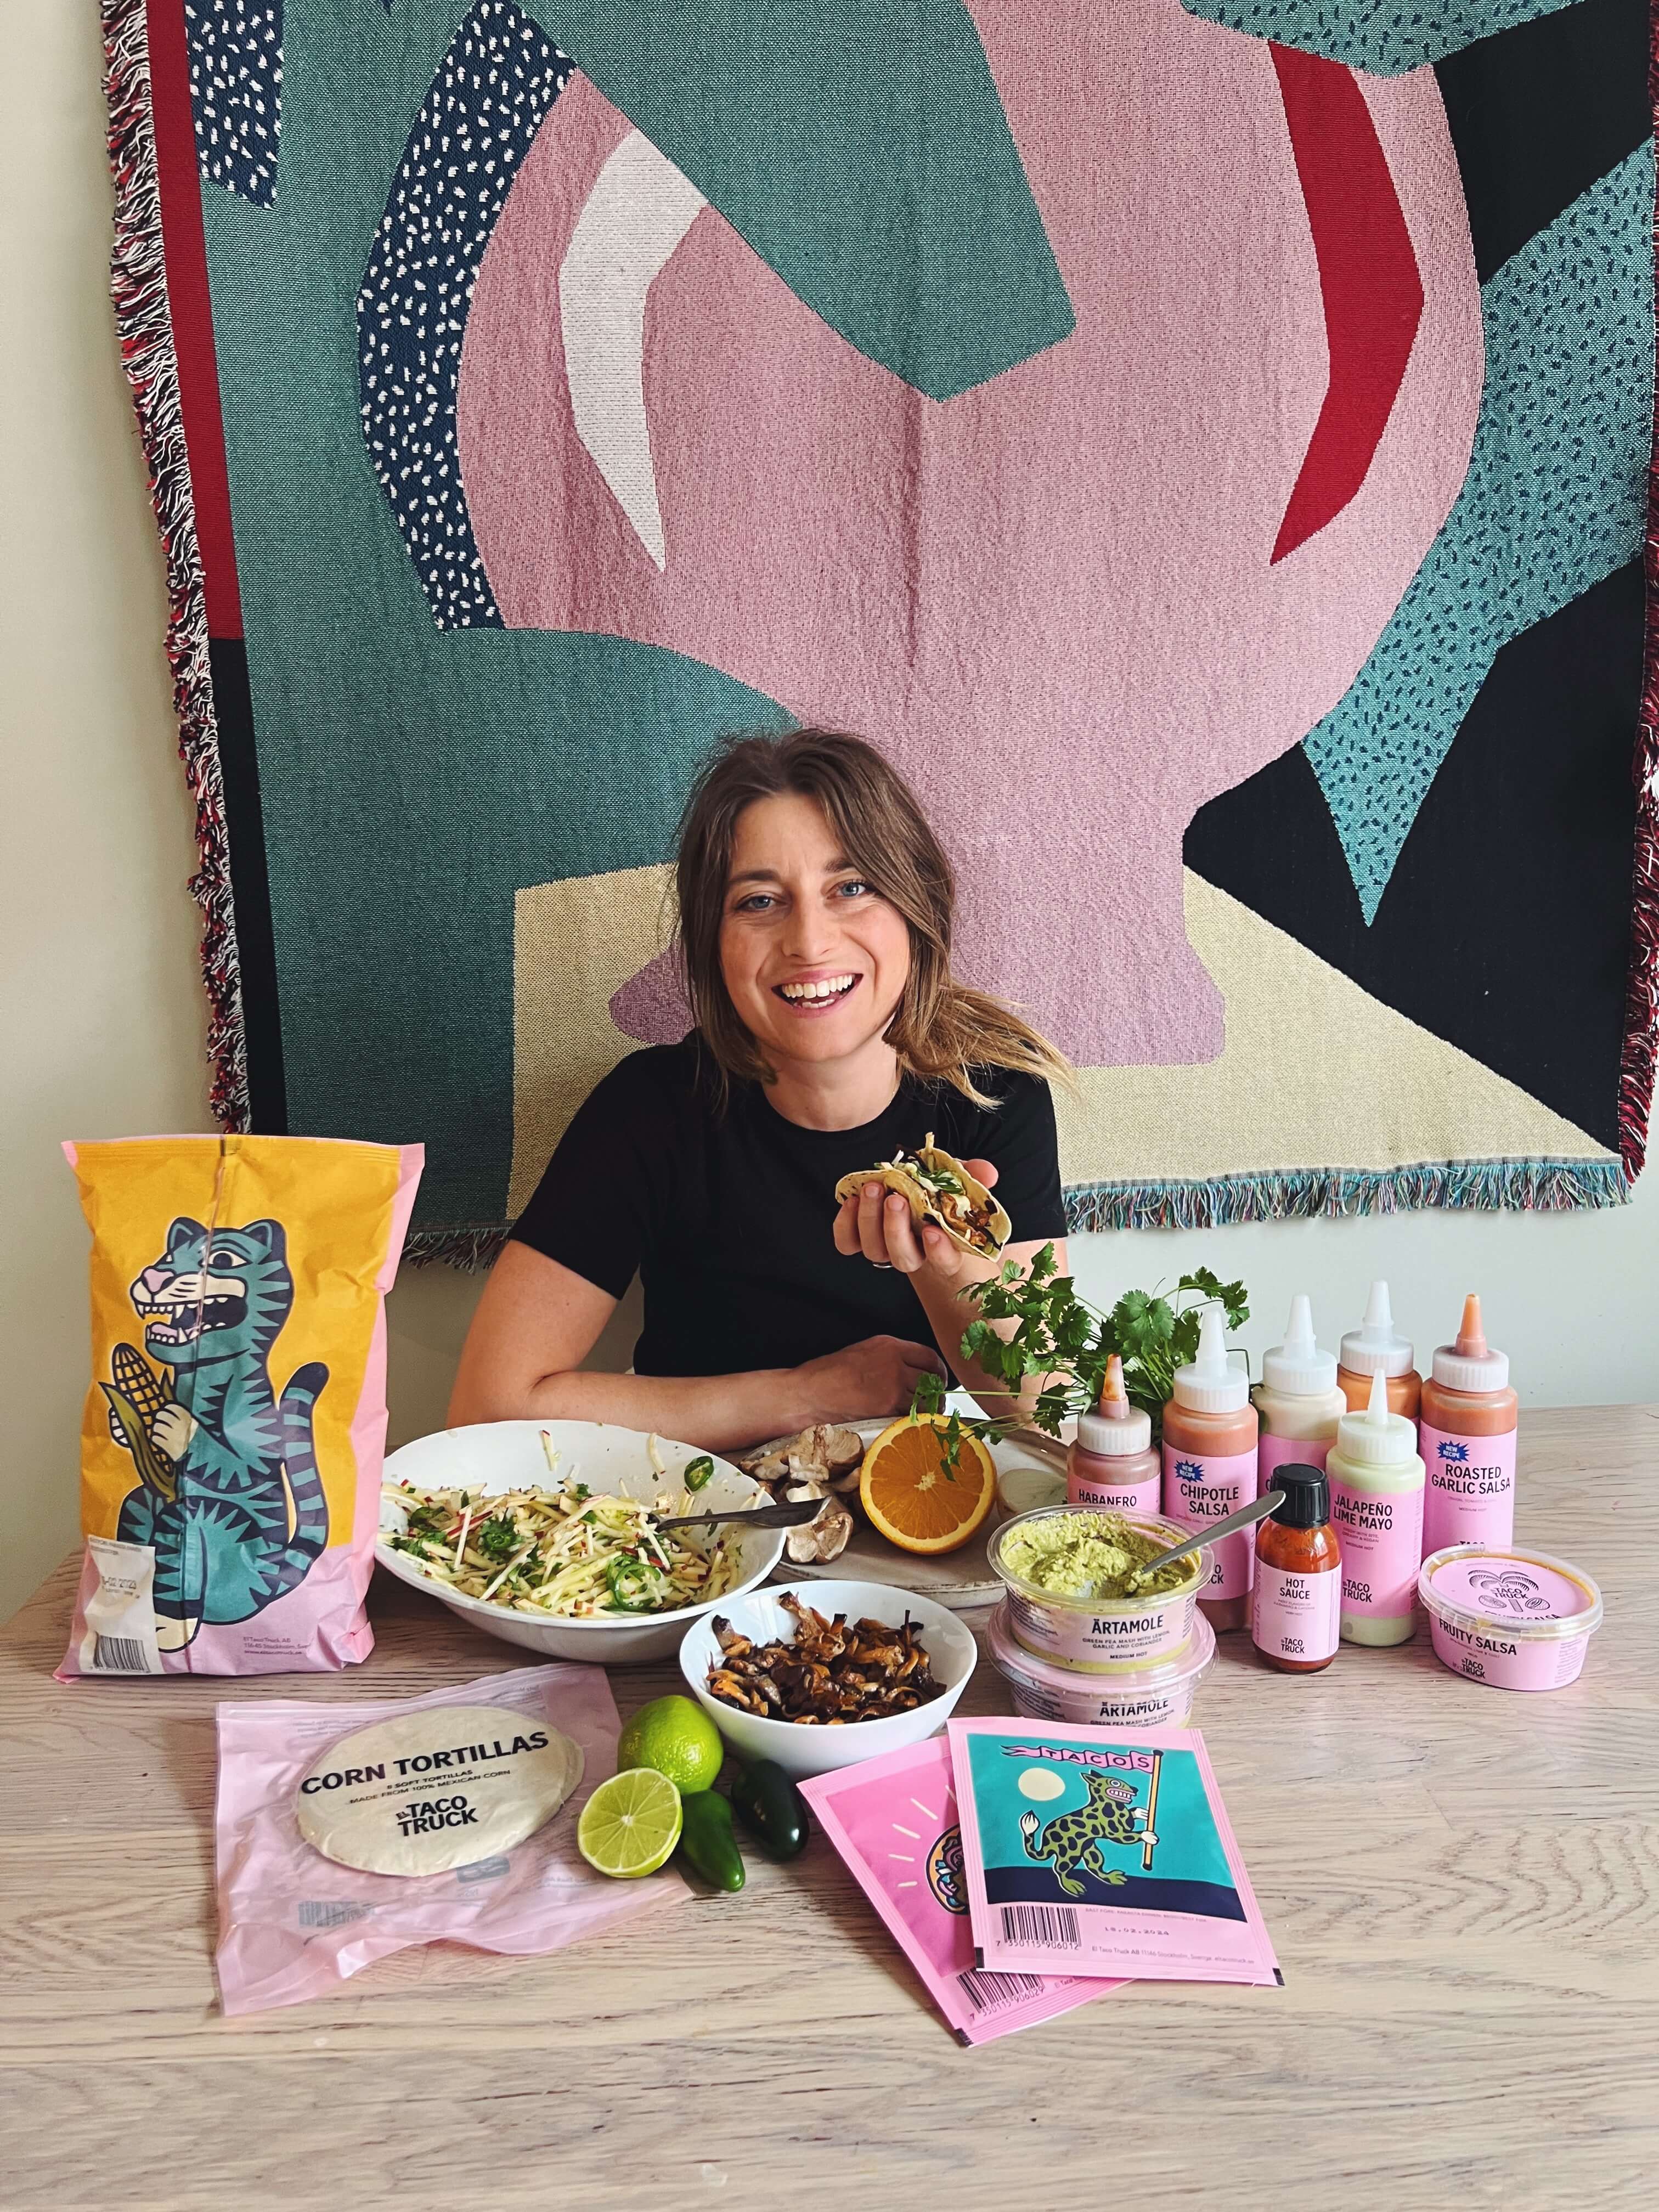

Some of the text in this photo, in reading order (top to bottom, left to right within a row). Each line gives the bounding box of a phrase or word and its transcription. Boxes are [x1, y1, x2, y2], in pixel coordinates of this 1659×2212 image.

[1443, 1450, 1460, 1459] RECIPE
[1182, 1464, 1193, 1472] NEW
[1445, 1463, 1502, 1480] ROASTED
[1180, 1483, 1239, 1501] CHIPOTLE
[1431, 1474, 1510, 1494] GARLIC SALSA
[1189, 1500, 1229, 1516] SALSA
[1334, 1494, 1392, 1516] JALAPEÑO
[1334, 1506, 1392, 1530] LIME MAYO
[1285, 1577, 1305, 1589] HOT
[1346, 1579, 1370, 1593] TACO
[1279, 1587, 1310, 1600] SAUCE
[1342, 1587, 1372, 1603] TRUCK
[1284, 1637, 1303, 1646] TACO
[1439, 1618, 1473, 1645] FRUITY
[1475, 1635, 1517, 1656] SALSA
[1281, 1643, 1305, 1654] TRUCK
[1462, 1663, 1486, 1679] TRUCK
[1464, 1657, 1483, 1671] TACO
[301, 1731, 549, 1794] CORN TORTILLAS
[1045, 1750, 1150, 1768] TACOS
[349, 1770, 511, 1804] MADE FROM 100% MEXICAN CORN
[395, 1780, 420, 1788] SOFT
[423, 1769, 473, 1782] TORTILLAS
[396, 1795, 468, 1820] EL TACO
[397, 1807, 479, 1837] TRUCK
[1008, 1939, 1041, 1948] 350115
[1046, 1940, 1079, 1950] 906012
[982, 2000, 1012, 2017] 350115
